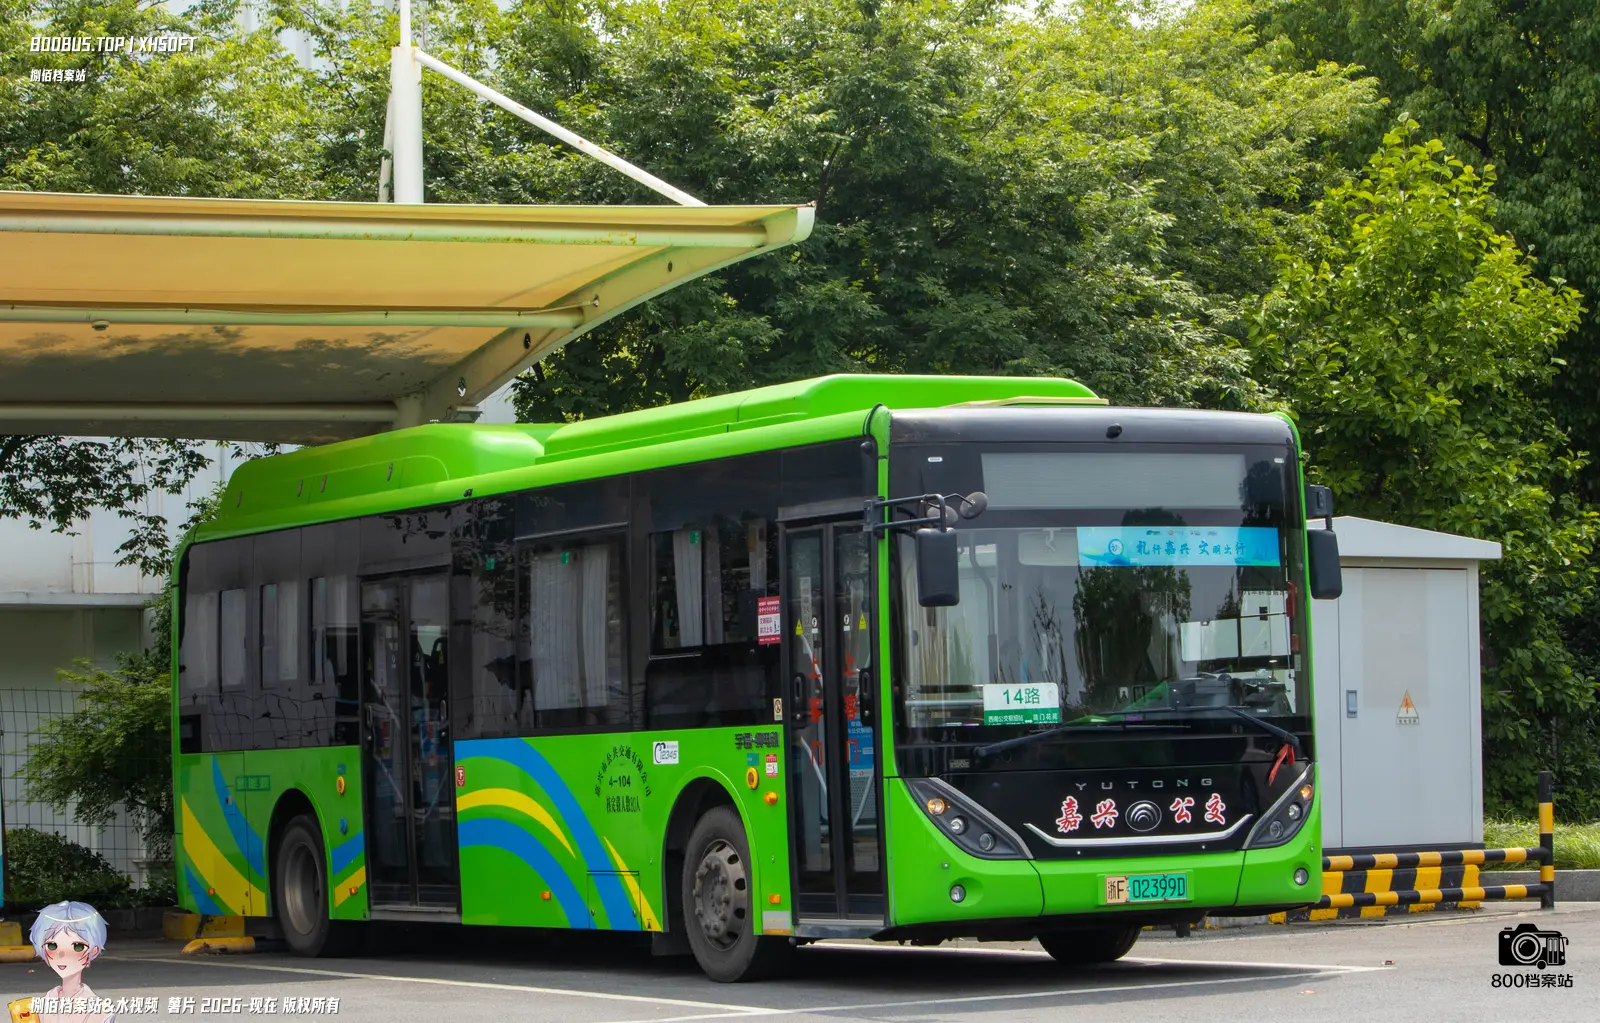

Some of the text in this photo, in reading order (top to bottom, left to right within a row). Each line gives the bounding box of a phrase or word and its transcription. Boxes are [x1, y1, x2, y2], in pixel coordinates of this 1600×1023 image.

[1136, 540, 1247, 556] 礼行嘉兴 文明出行
[1002, 687, 1041, 705] 14路
[659, 750, 678, 760] 12345
[608, 775, 631, 787] 4-104
[1075, 778, 1213, 791] YUTONG
[1055, 793, 1226, 833] 嘉兴 公交
